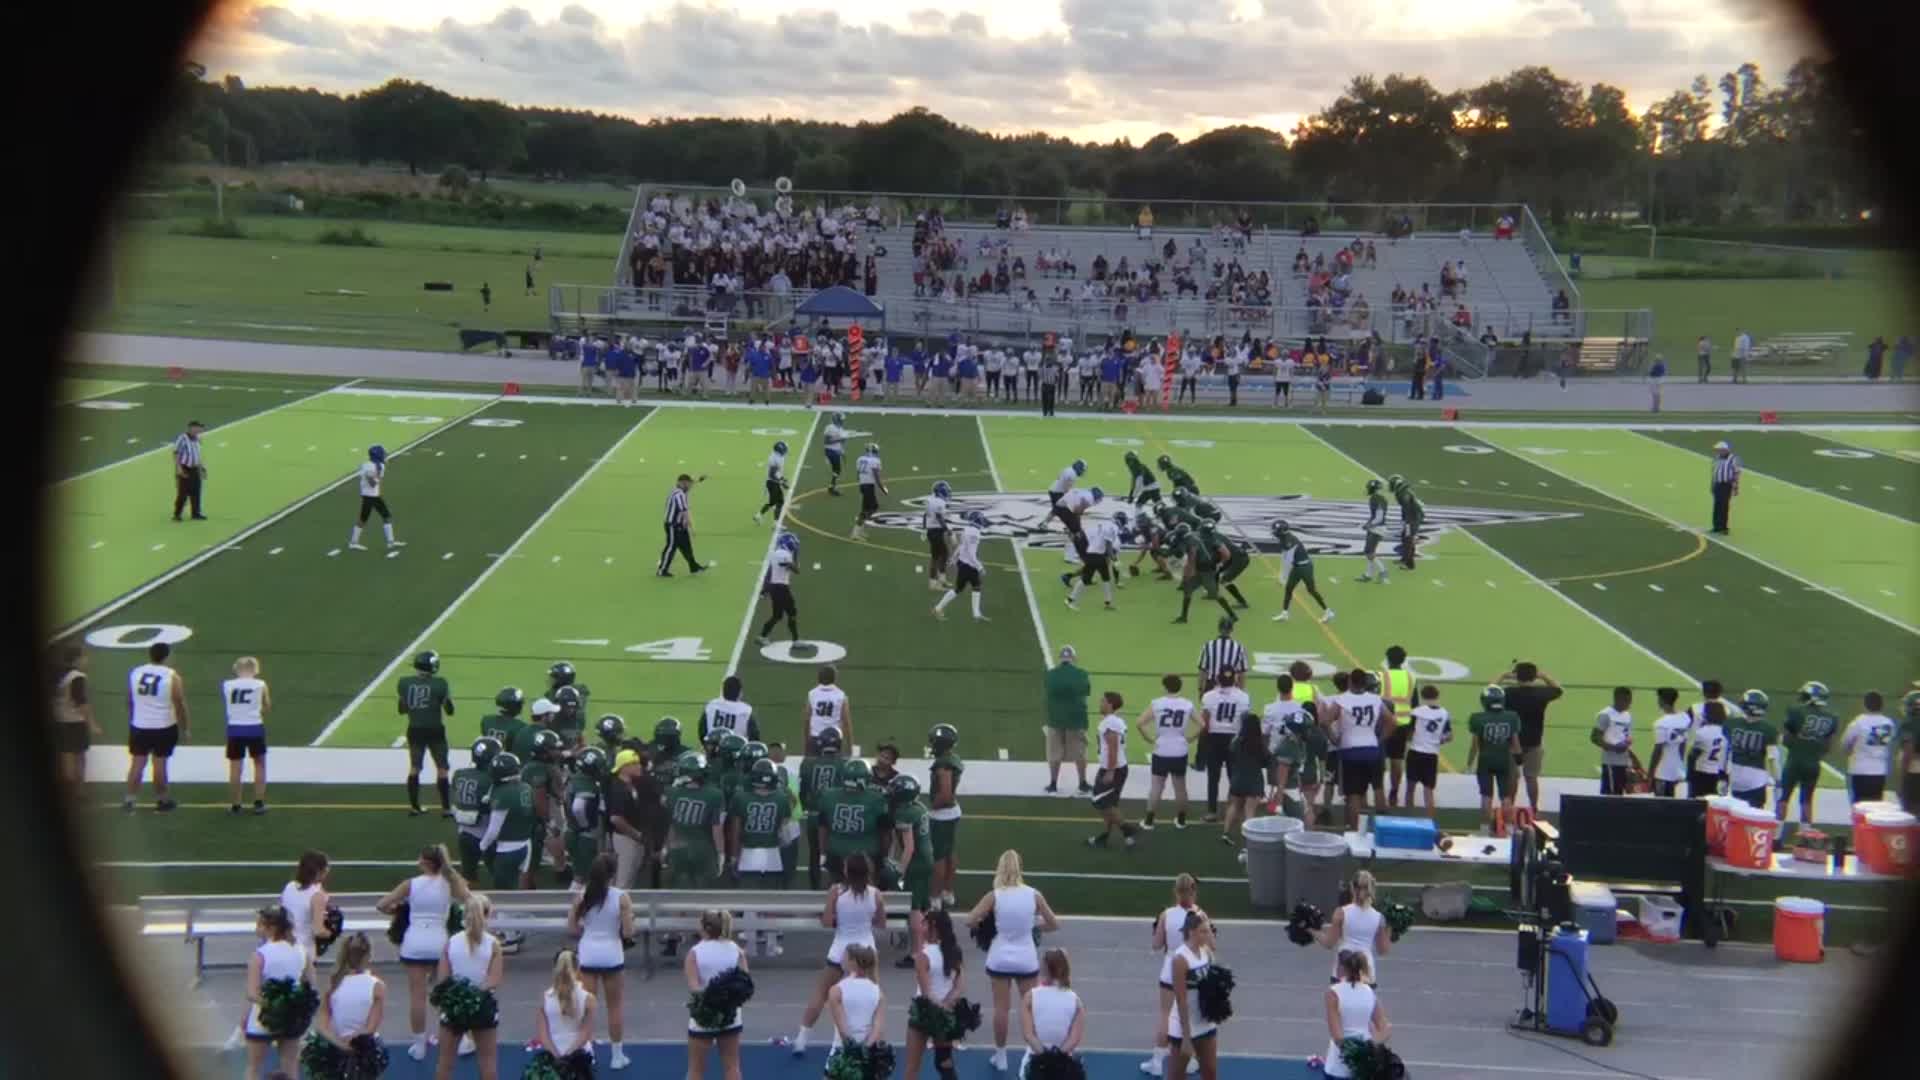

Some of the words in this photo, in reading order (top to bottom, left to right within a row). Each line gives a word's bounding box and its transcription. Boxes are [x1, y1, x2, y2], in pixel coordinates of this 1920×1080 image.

[138, 673, 161, 696] 51
[1159, 708, 1184, 728] 28
[832, 803, 865, 833] 55
